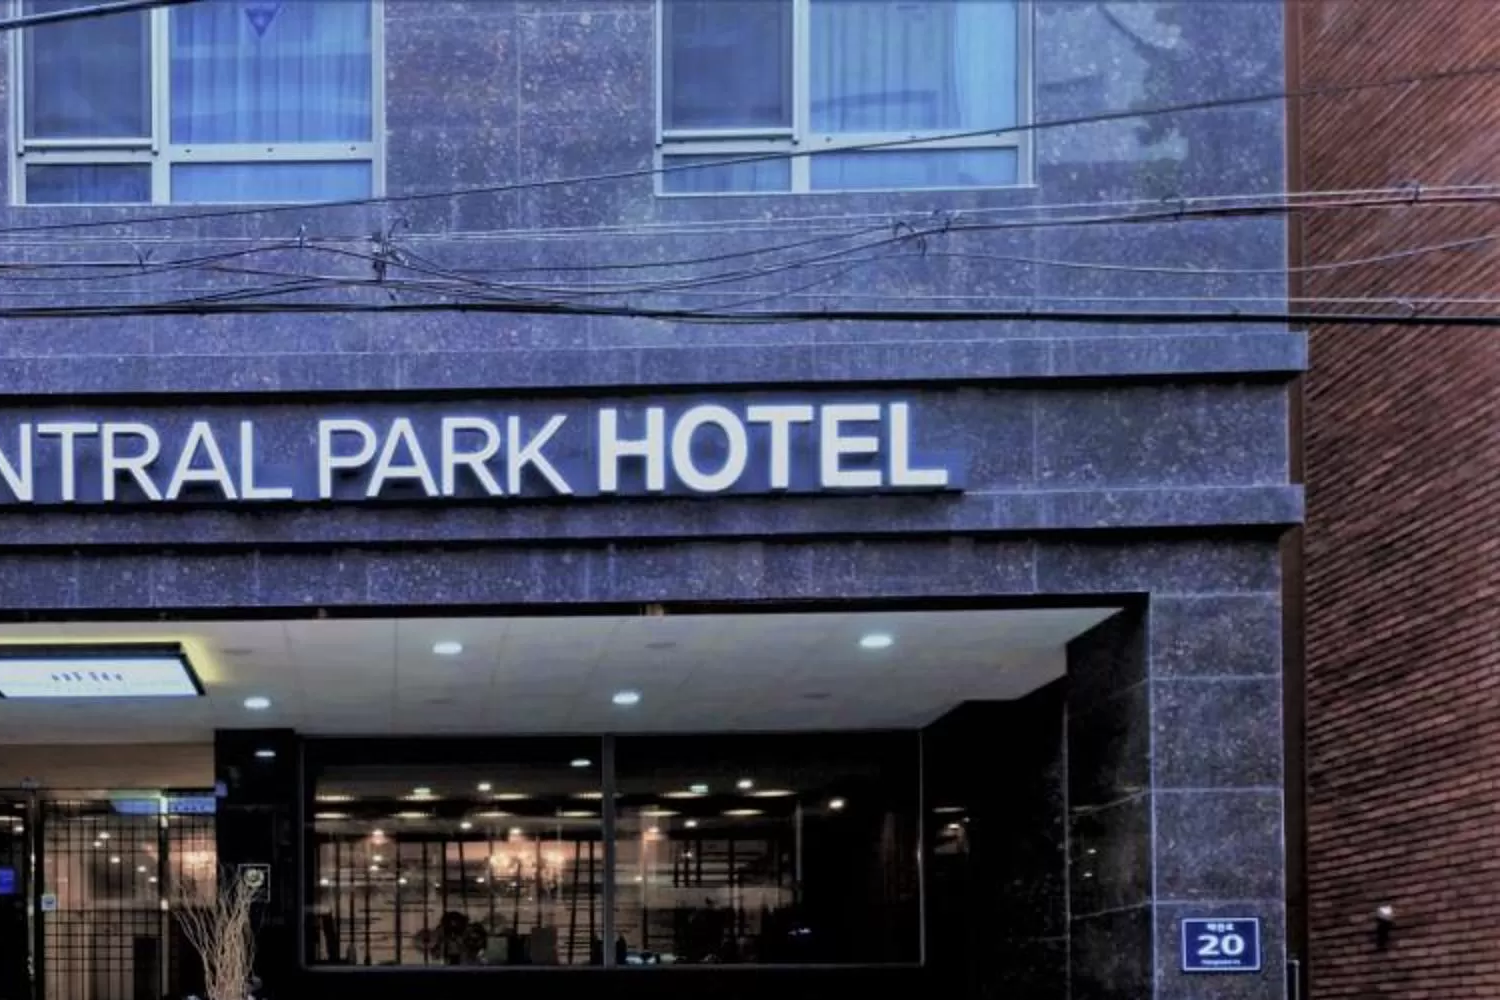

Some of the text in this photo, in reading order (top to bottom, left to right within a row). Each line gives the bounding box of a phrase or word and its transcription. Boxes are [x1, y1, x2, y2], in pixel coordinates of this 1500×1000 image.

[317, 415, 573, 499] PARK
[599, 402, 949, 492] HOTEL
[1197, 933, 1245, 956] 20
